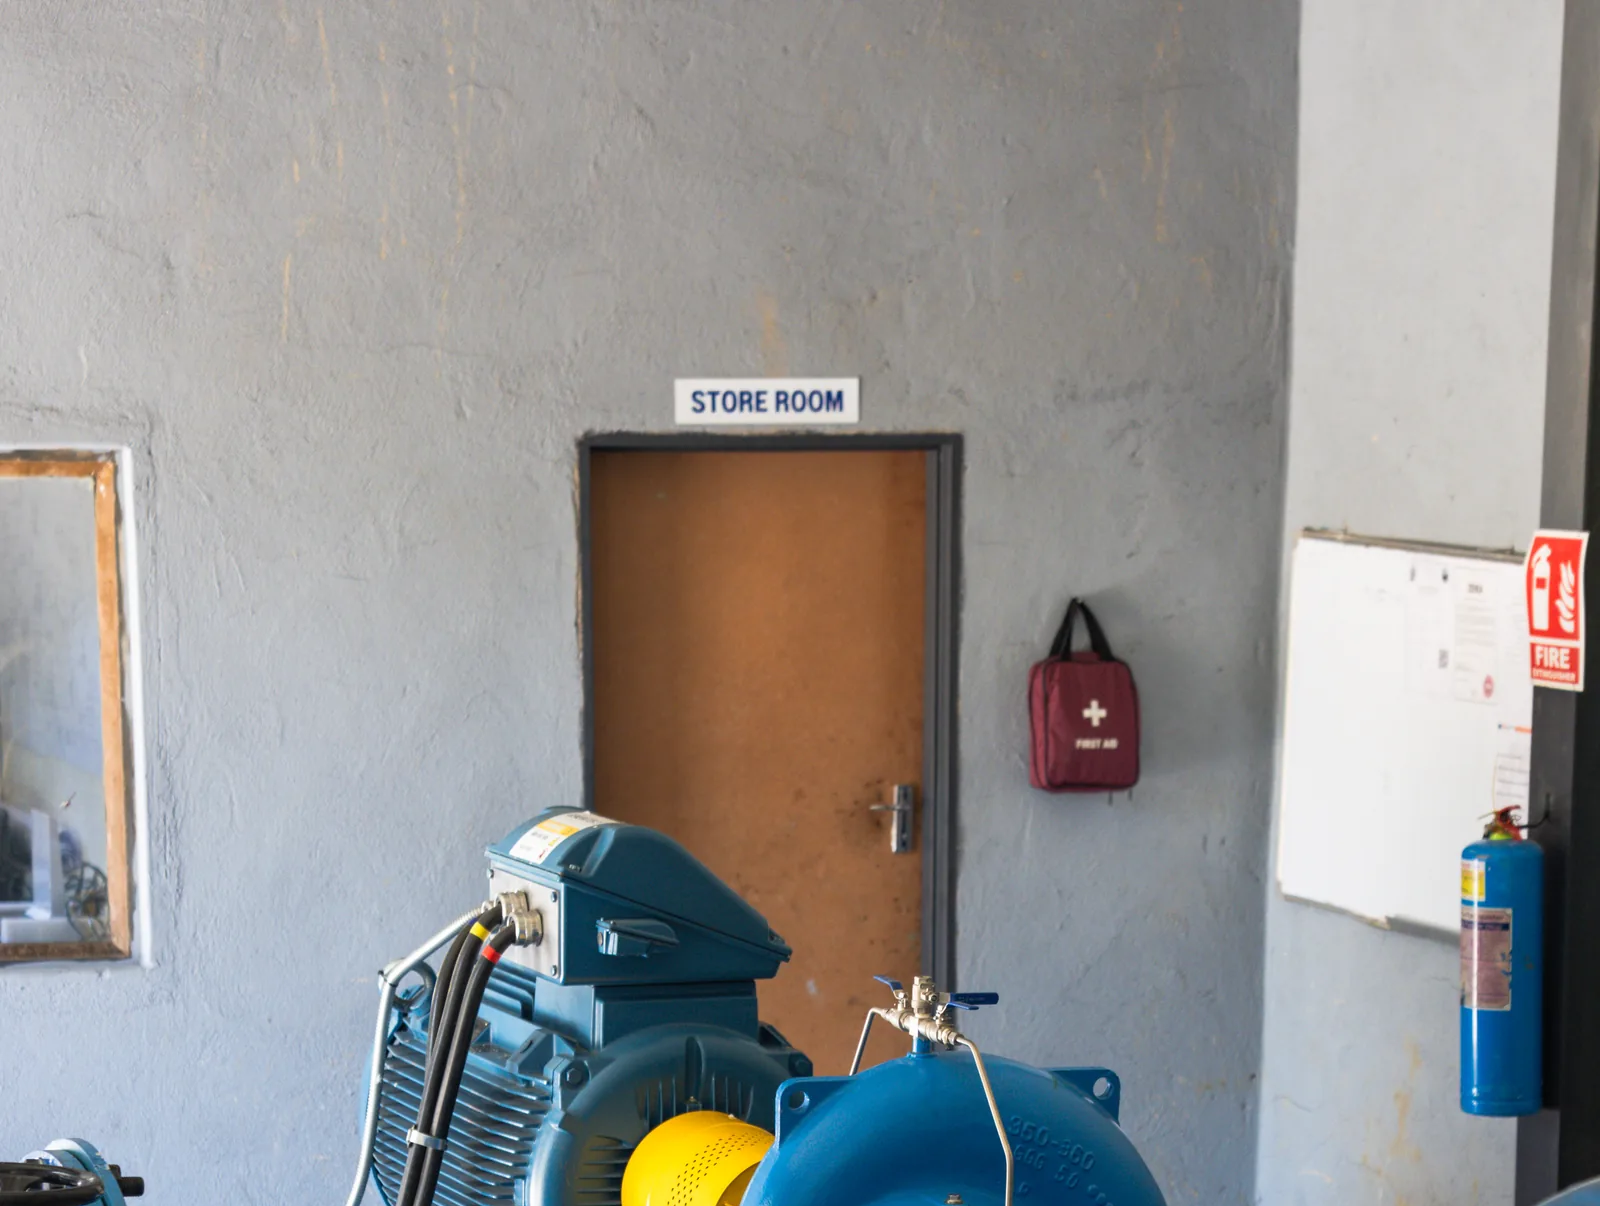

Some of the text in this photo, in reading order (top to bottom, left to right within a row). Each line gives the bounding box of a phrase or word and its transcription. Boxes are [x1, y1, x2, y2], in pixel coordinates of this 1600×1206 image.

[691, 389, 844, 413] STORE ROOM
[1535, 645, 1570, 669] FIRE
[1075, 738, 1118, 750] FIRST AID
